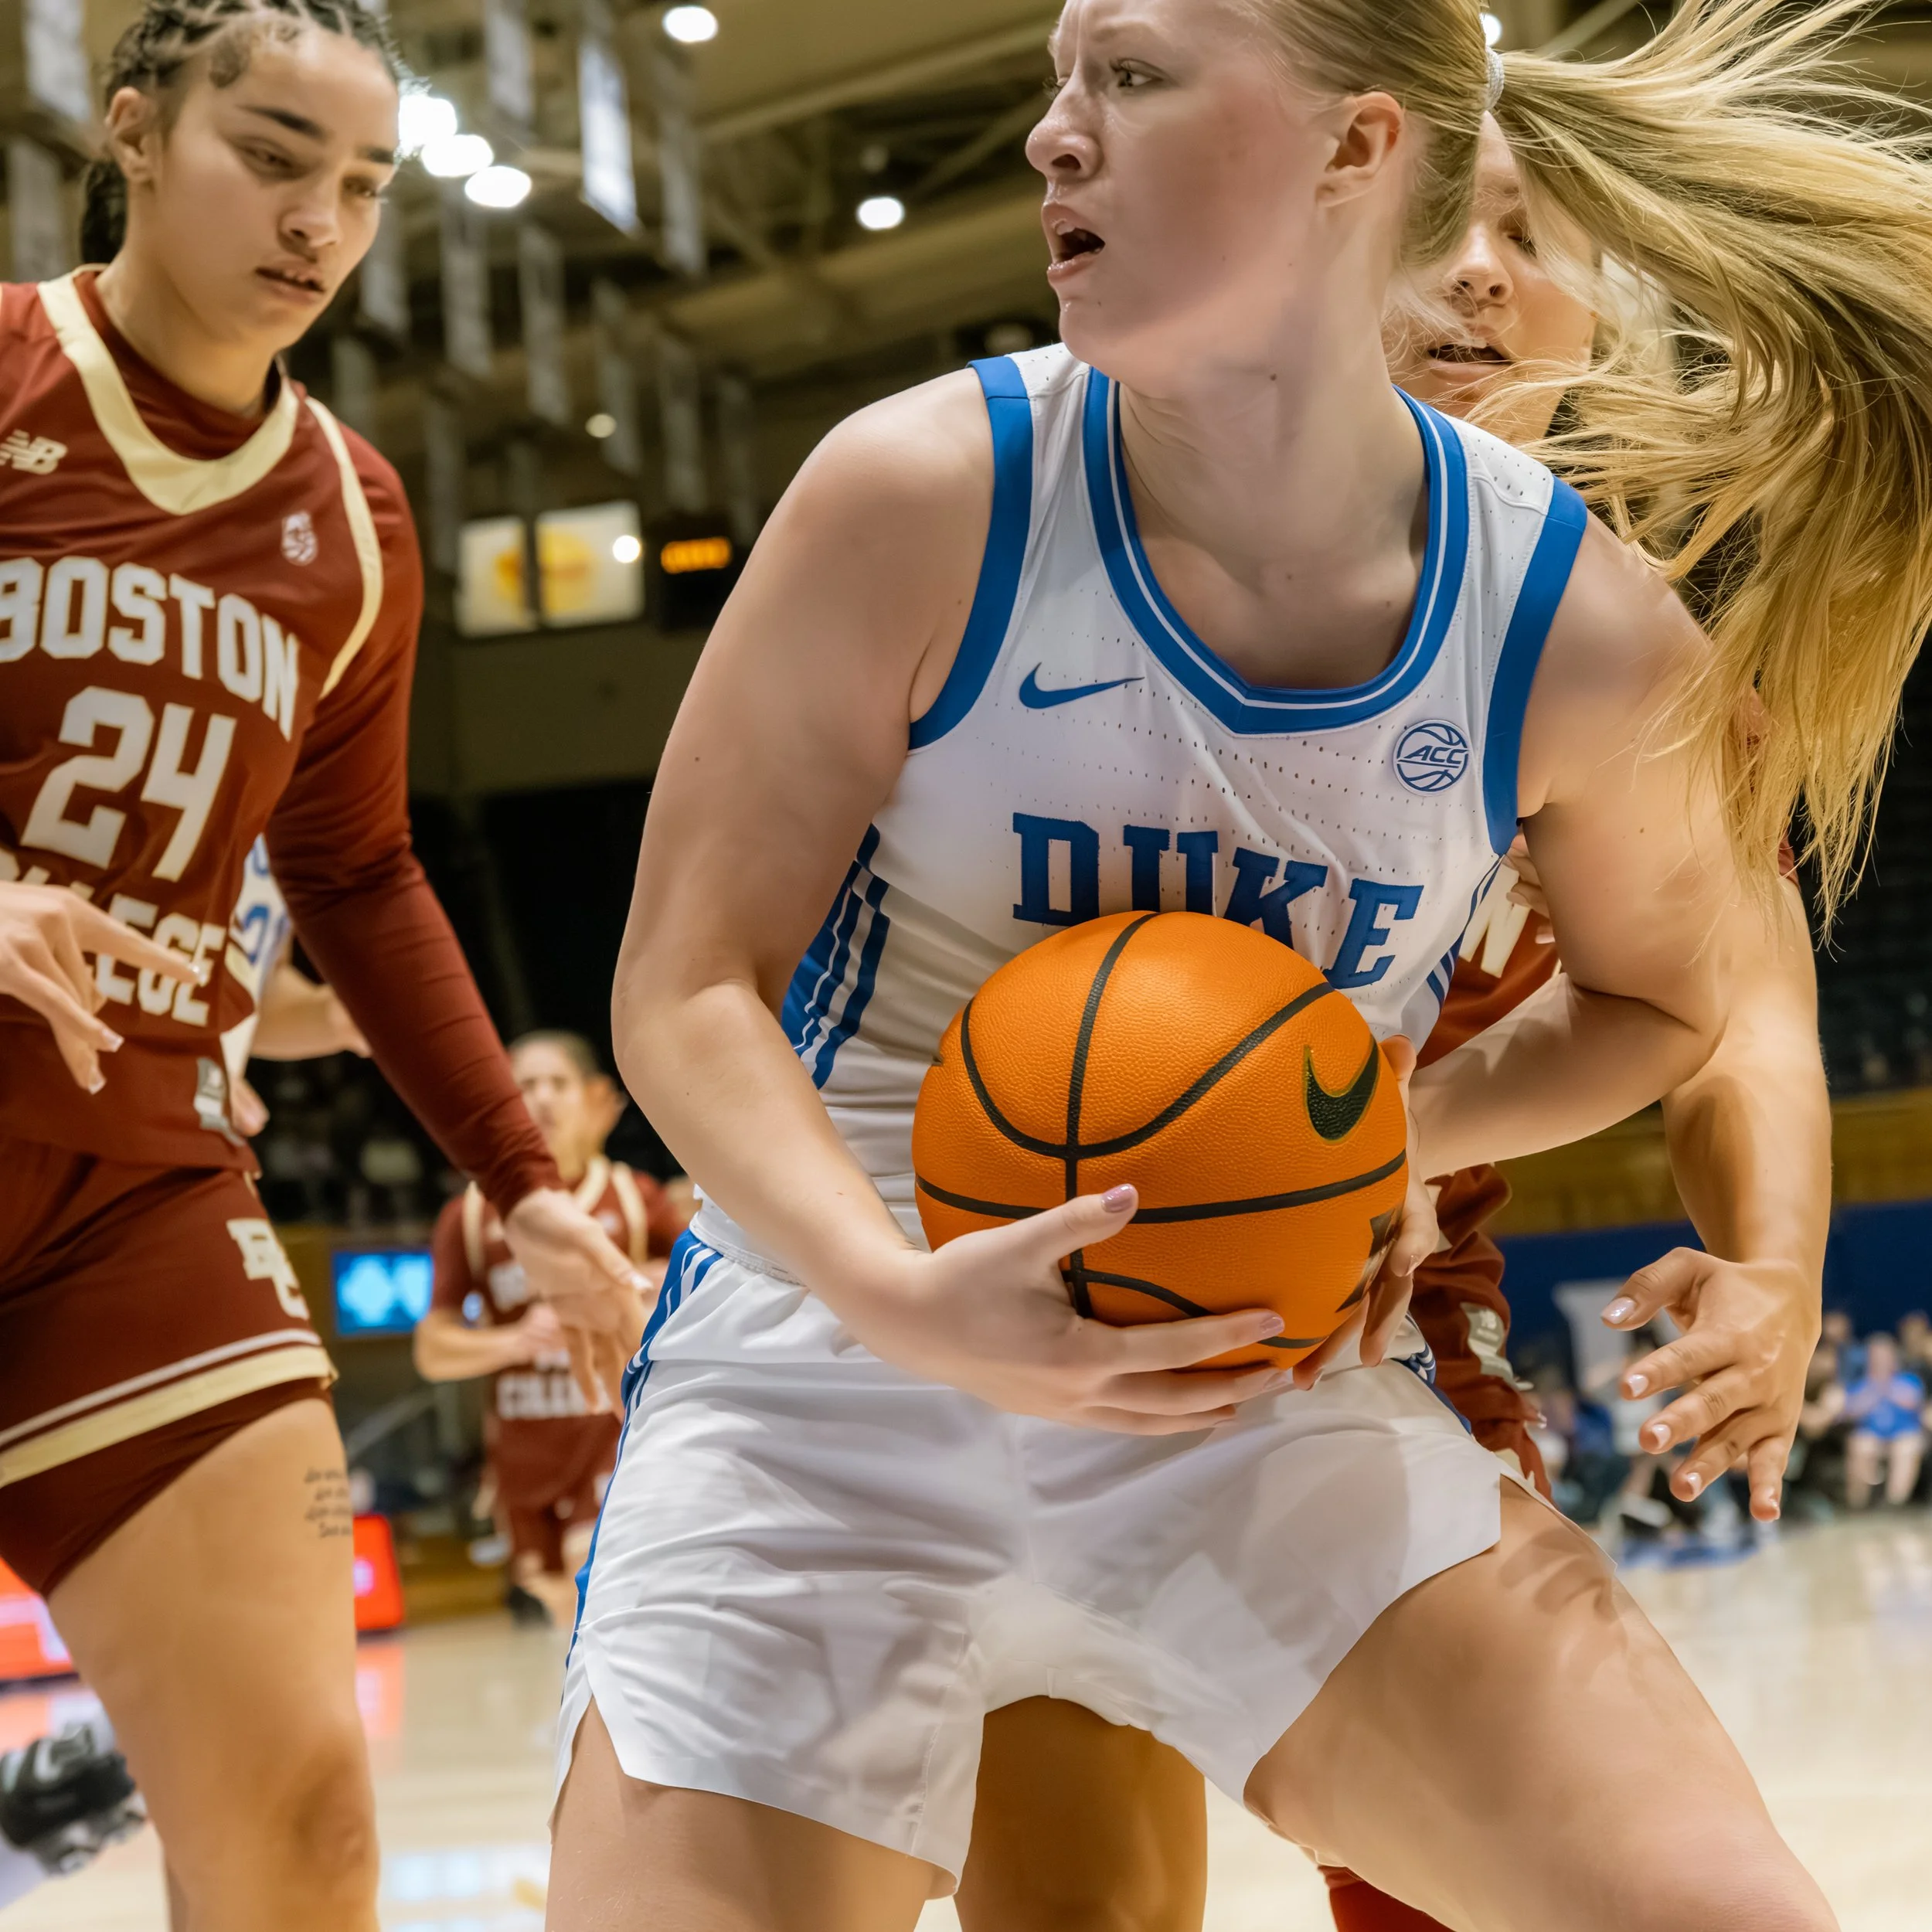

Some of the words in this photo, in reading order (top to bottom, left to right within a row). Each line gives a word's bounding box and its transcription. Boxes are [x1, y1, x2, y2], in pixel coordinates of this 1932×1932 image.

[0, 556, 299, 743] BOSTON
[21, 685, 237, 883] 24
[1403, 745, 1468, 764] ACC
[1012, 812, 1423, 989] DUKE
